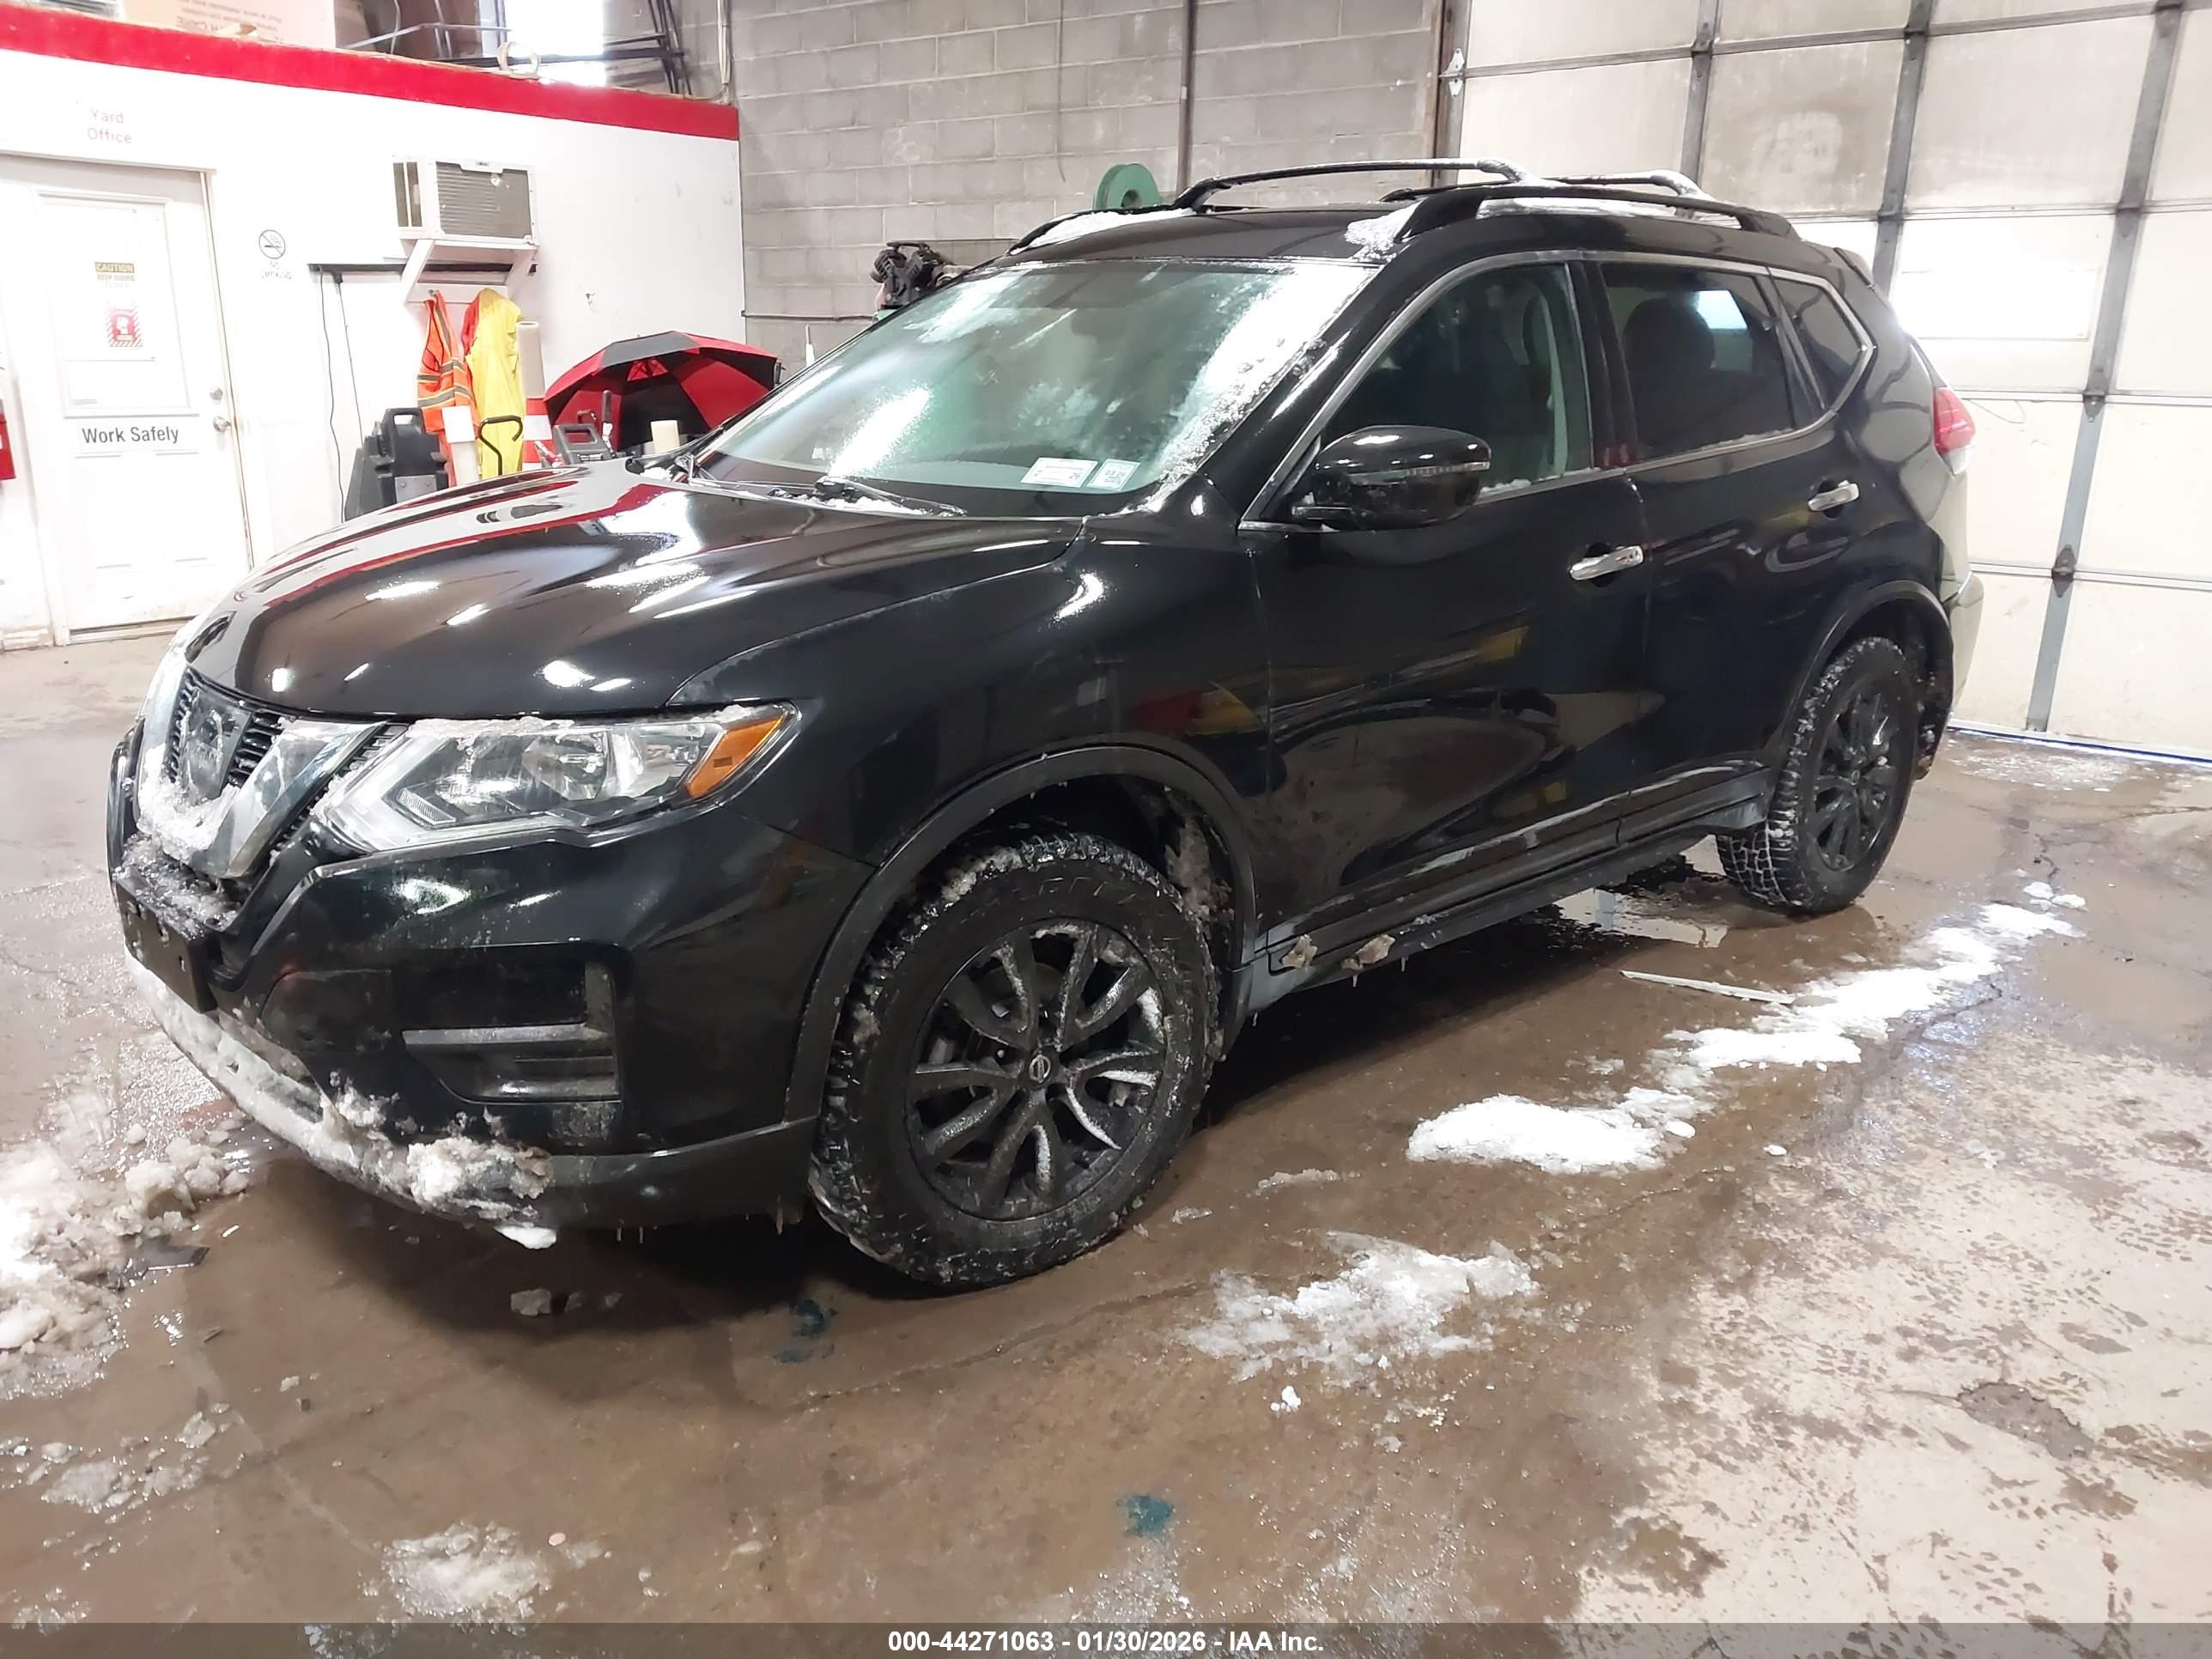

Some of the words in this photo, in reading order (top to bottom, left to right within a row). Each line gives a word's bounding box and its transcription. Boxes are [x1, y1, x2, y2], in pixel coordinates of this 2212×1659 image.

[89, 108, 125, 124] Yard
[88, 127, 132, 144] Office
[82, 427, 125, 443] Work
[131, 426, 179, 444] Safely
